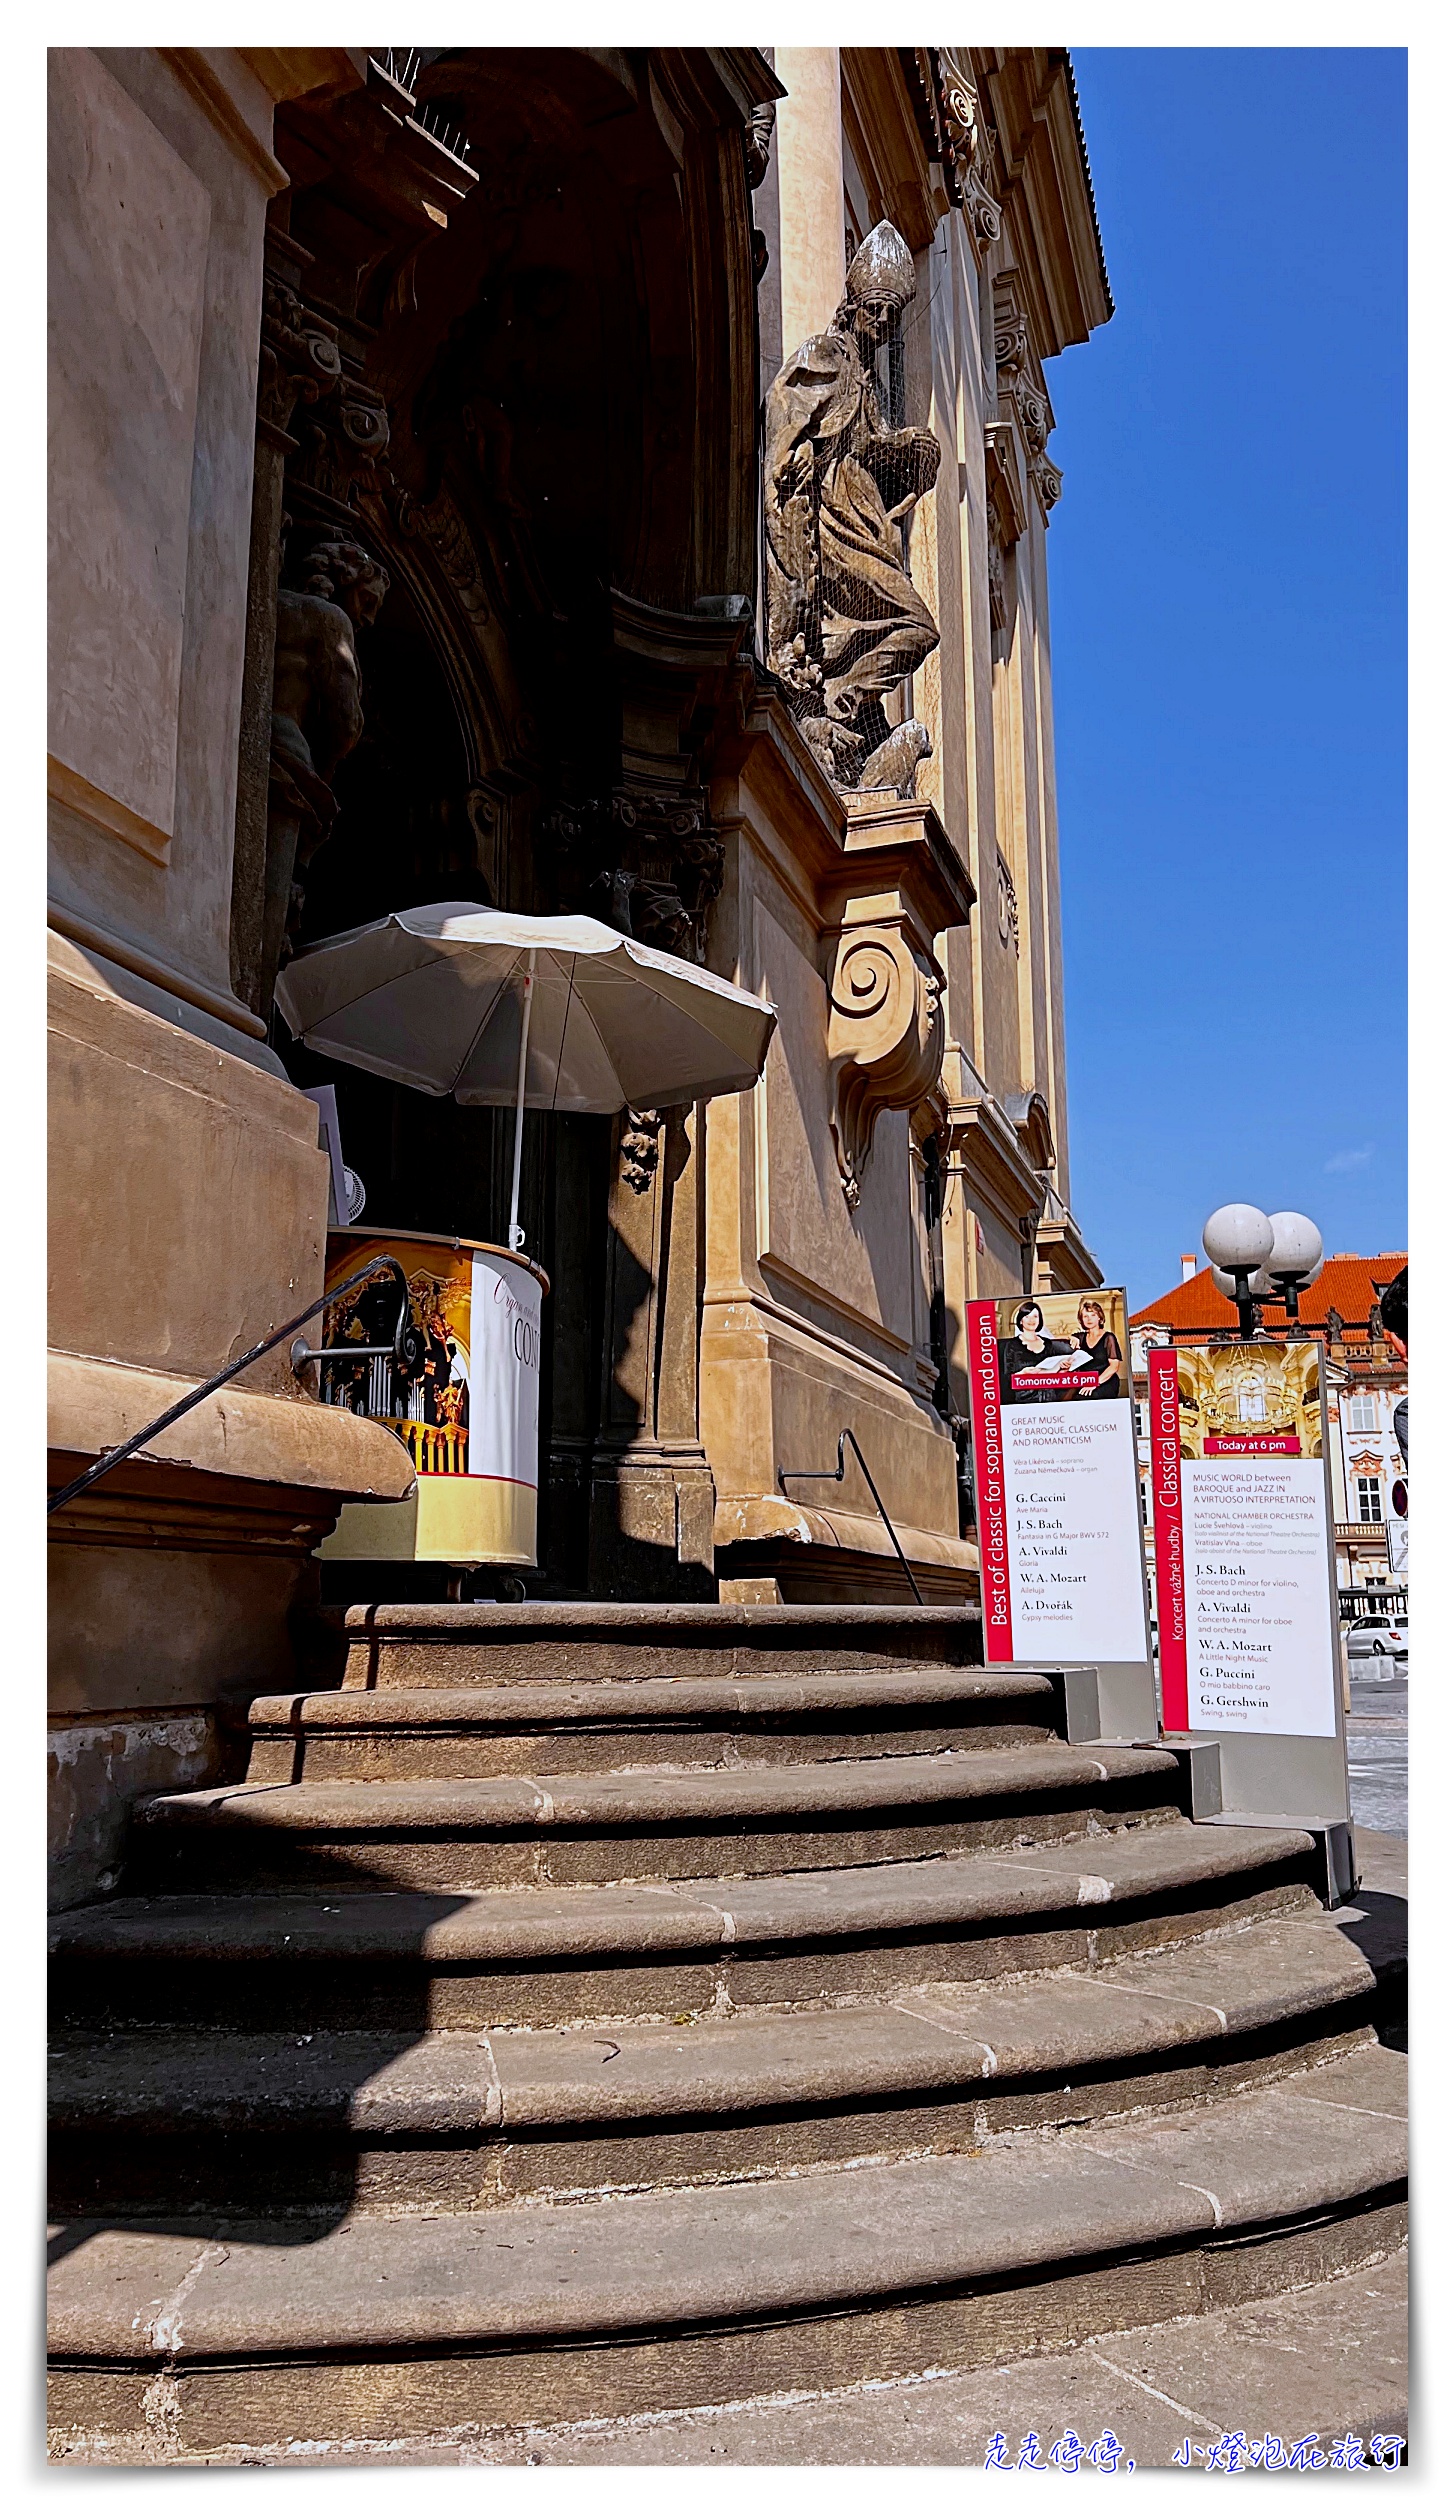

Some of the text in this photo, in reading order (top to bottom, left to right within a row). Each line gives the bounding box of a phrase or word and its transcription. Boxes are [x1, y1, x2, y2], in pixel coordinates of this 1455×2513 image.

[515, 1318, 540, 1373] CON
[1014, 1375, 1096, 1387] Tomorrow at 6 pm
[1158, 1368, 1175, 1432] concert
[1011, 1416, 1065, 1425] GREAT MUSIC
[1012, 1424, 1117, 1436] OF BAROQUE, CLASSICISM
[1033, 1436, 1091, 1445] ROMANTICISM
[1217, 1440, 1286, 1452] Today at 6 pm
[978, 1315, 1007, 1625] Best of classic for soprano and organ
[1157, 1438, 1178, 1507] Classical
[1193, 1485, 1234, 1493] BAROQUE
[1016, 1493, 1066, 1503] G. Caccini
[1016, 1519, 1063, 1532] J. S. Bach
[1060, 1532, 1078, 1540] Major
[1167, 1526, 1182, 1560] hudby
[1019, 1546, 1068, 1556] A. Vivaldi
[1195, 1565, 1246, 1576] J. S. Bach
[1020, 1573, 1087, 1583] W. A. Mozart
[1169, 1564, 1182, 1595] vážné
[1272, 1580, 1298, 1588] violino,
[1022, 1600, 1073, 1610] A. Dvořák
[1198, 1603, 1251, 1613] A. Vivaldi
[1172, 1598, 1183, 1640] Koncert
[1199, 1640, 1272, 1652] W. A. Mozart
[1226, 1654, 1245, 1663] Night
[1200, 1667, 1255, 1679] G. Puccini
[1201, 1695, 1269, 1708] G. Gershwin
[1201, 1709, 1248, 1719] Swing, swing
